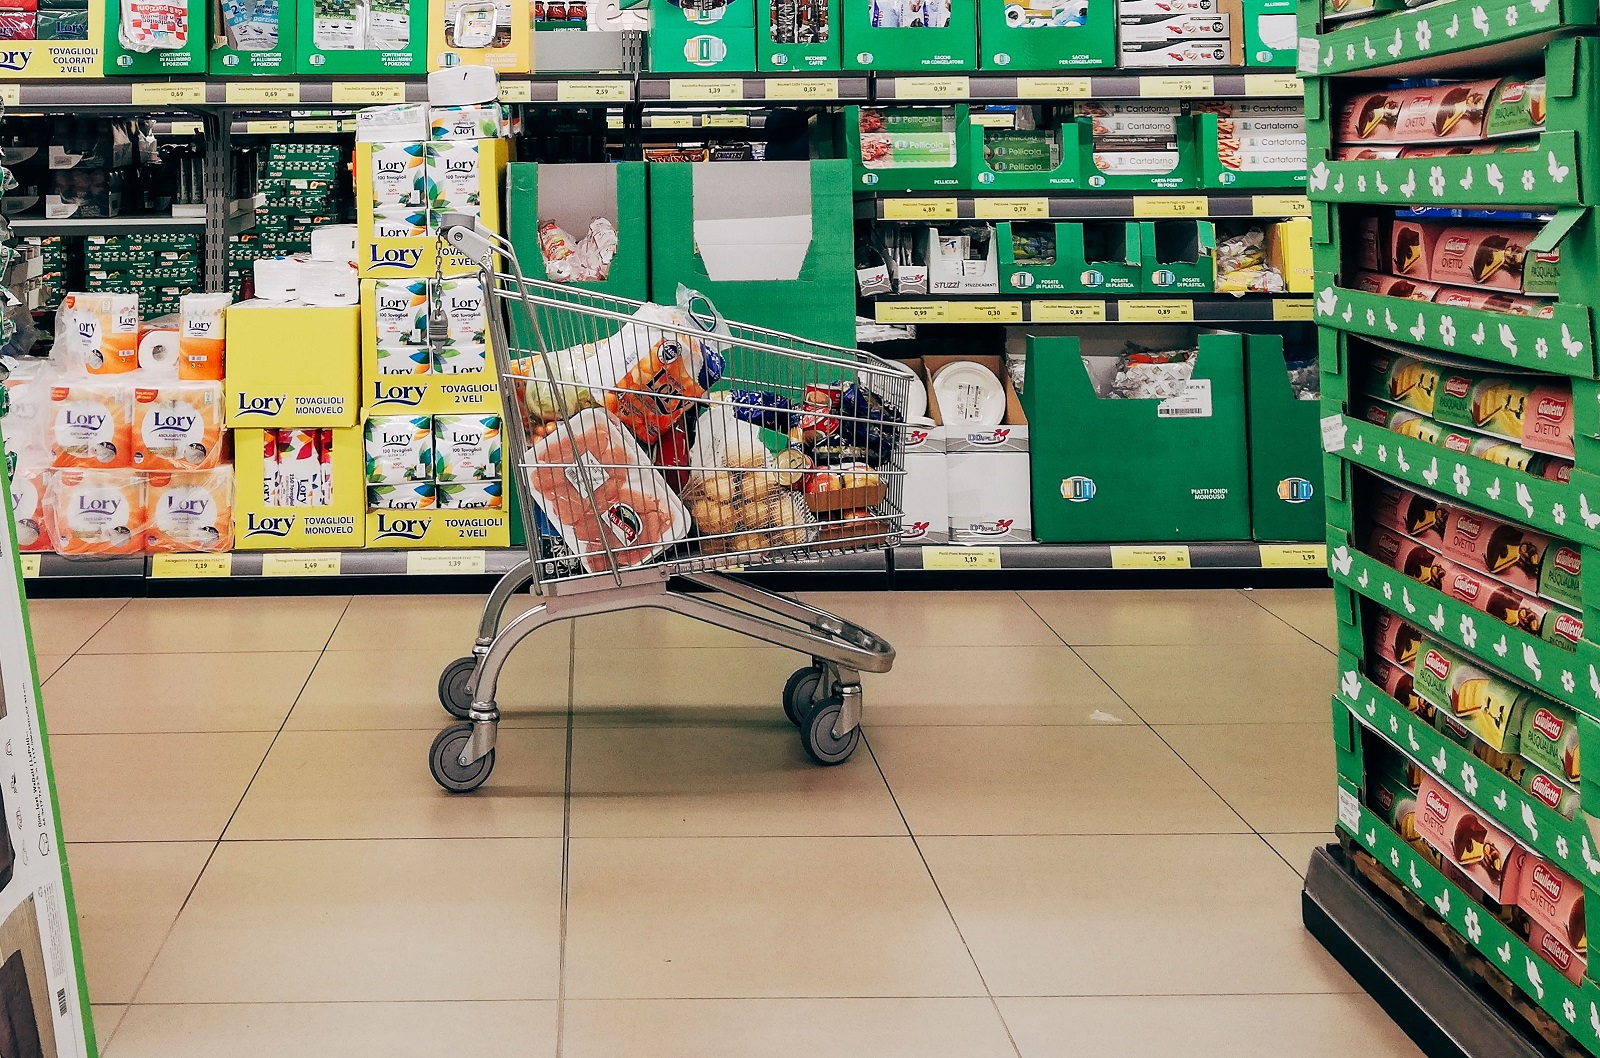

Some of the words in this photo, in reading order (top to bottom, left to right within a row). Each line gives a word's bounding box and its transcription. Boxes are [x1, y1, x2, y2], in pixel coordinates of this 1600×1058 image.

[56, 22, 87, 35] Lory
[0, 50, 33, 71] ory
[1126, 105, 1170, 113] Cartaforno
[1253, 105, 1297, 113] Cartaforno
[1127, 122, 1171, 130] Cartaforno
[1254, 122, 1299, 130] Cartaforno
[1405, 117, 1426, 128] OVETTO
[452, 126, 475, 137] Lory
[909, 141, 944, 149] Pellicola
[1262, 138, 1306, 146] Cartaforno
[715, 151, 745, 160] SNICKERS
[1009, 148, 1042, 156] Pellicola
[378, 159, 407, 174] Lory
[445, 159, 476, 174] Lory
[1009, 163, 1042, 171] Pellicola
[1129, 157, 1173, 165] Cartaforno
[1263, 156, 1307, 164] Cartaforno
[380, 227, 409, 237] Lory
[370, 244, 423, 270] Lory
[451, 257, 456, 266] 2
[459, 257, 476, 266] VEL
[1442, 257, 1463, 269] OVETTO
[380, 296, 409, 312] Lory
[451, 297, 481, 312] Lory
[119, 315, 136, 326] Lory
[188, 320, 212, 331] Lory
[79, 322, 96, 337] ory
[370, 381, 428, 408] Lory
[441, 385, 498, 393] TOVAGLIOLI
[234, 393, 287, 418] Lory
[295, 397, 344, 405] TOVAGLIOLI
[462, 395, 483, 403] VELI
[1538, 400, 1566, 419] Giulietta
[66, 411, 106, 431] Lory
[154, 412, 196, 433] Lory
[1534, 421, 1561, 438] OVETTO
[383, 432, 413, 446] Lory
[452, 431, 482, 446] Lory
[297, 479, 309, 504] Lory
[79, 495, 121, 515] Lory
[167, 495, 209, 515] Lory
[389, 499, 417, 509] Lory
[458, 499, 487, 509] Lory
[243, 513, 296, 539] Lory
[304, 516, 354, 524] TOVAGLIOLI
[373, 514, 432, 541] Lory
[445, 518, 503, 527] TOVAGLIOLI
[305, 526, 353, 534] MONOVELO
[467, 529, 487, 537] VELI
[1457, 518, 1481, 538] Giulietta
[1453, 535, 1476, 553] OVETTO
[1556, 550, 1581, 573] Giulietta
[1454, 576, 1478, 598] Giulietta
[1556, 616, 1583, 639] Giulietta
[1426, 654, 1448, 677] Giulietta
[1419, 669, 1447, 695] PASQUALINA
[1534, 713, 1562, 738] Giulietta
[1527, 729, 1560, 760] PASQUALINA
[1532, 779, 1561, 806] Giulietta
[1427, 796, 1448, 820] Giulietta
[1424, 811, 1444, 836] OVETTO
[1533, 869, 1560, 898] Giulietta
[1530, 888, 1556, 917] OVETTO
[1543, 937, 1569, 966] Giulietta
